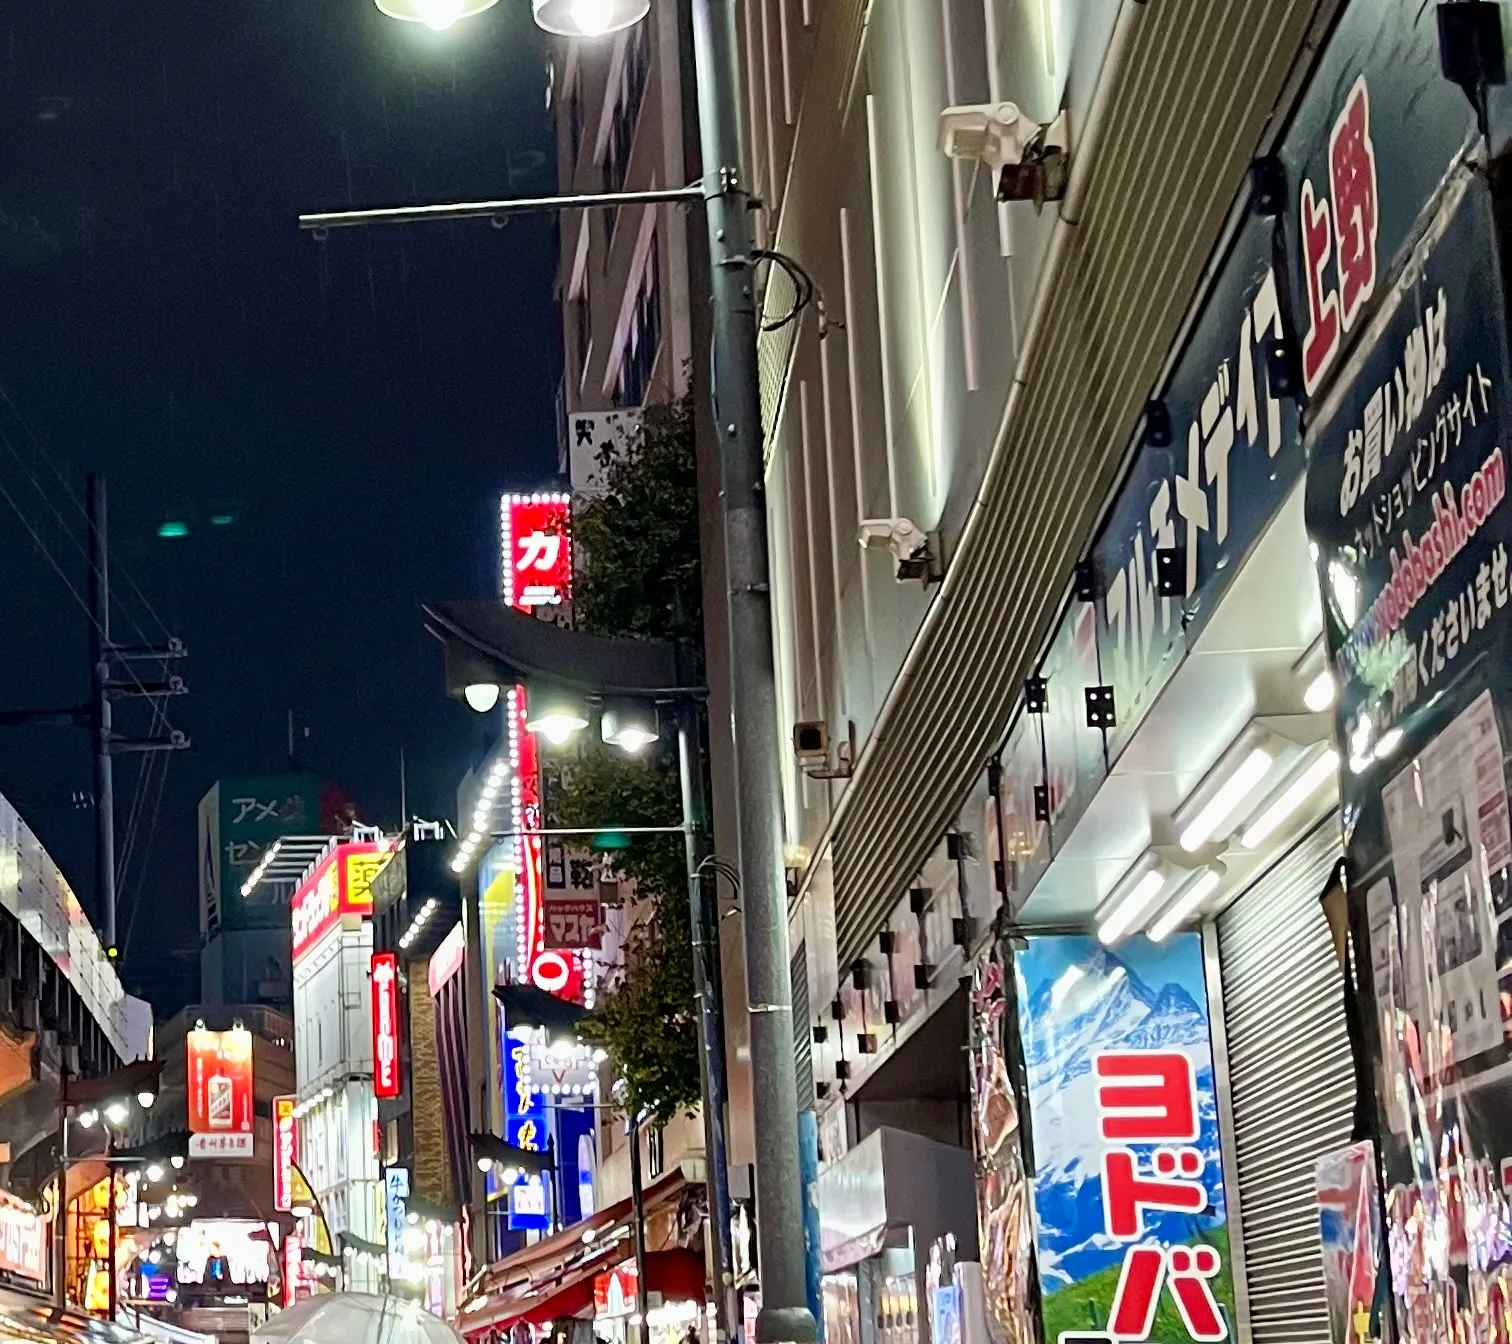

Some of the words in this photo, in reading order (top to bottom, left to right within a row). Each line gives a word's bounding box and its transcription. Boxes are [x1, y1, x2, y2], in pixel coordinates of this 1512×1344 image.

[1300, 73, 1378, 398] 上野
[1340, 287, 1447, 517] お買い物は
